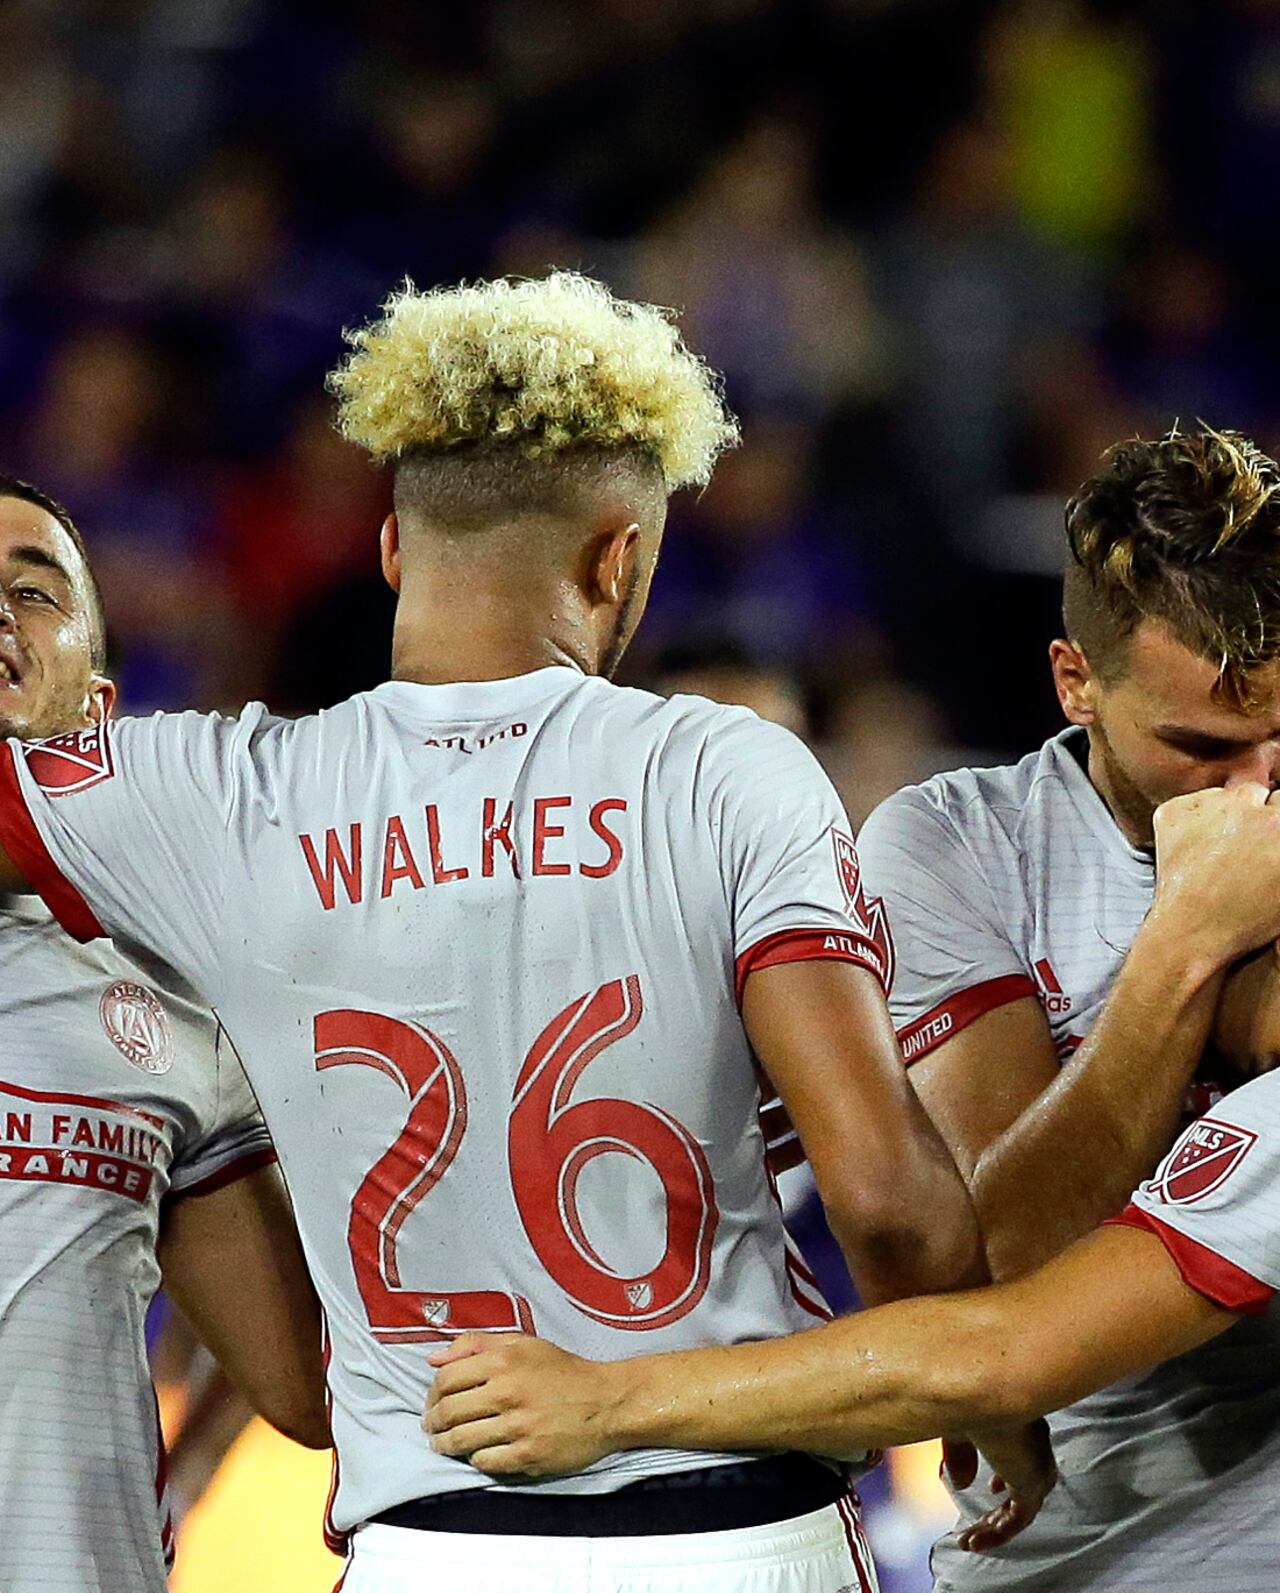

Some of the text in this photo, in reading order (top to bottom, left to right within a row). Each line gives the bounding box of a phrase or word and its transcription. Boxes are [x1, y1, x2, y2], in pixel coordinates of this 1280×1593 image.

[299, 795, 628, 911] WALKES
[902, 1012, 953, 1059] UNITED
[52, 1114, 163, 1163] FAMILY
[313, 974, 719, 1344] 26
